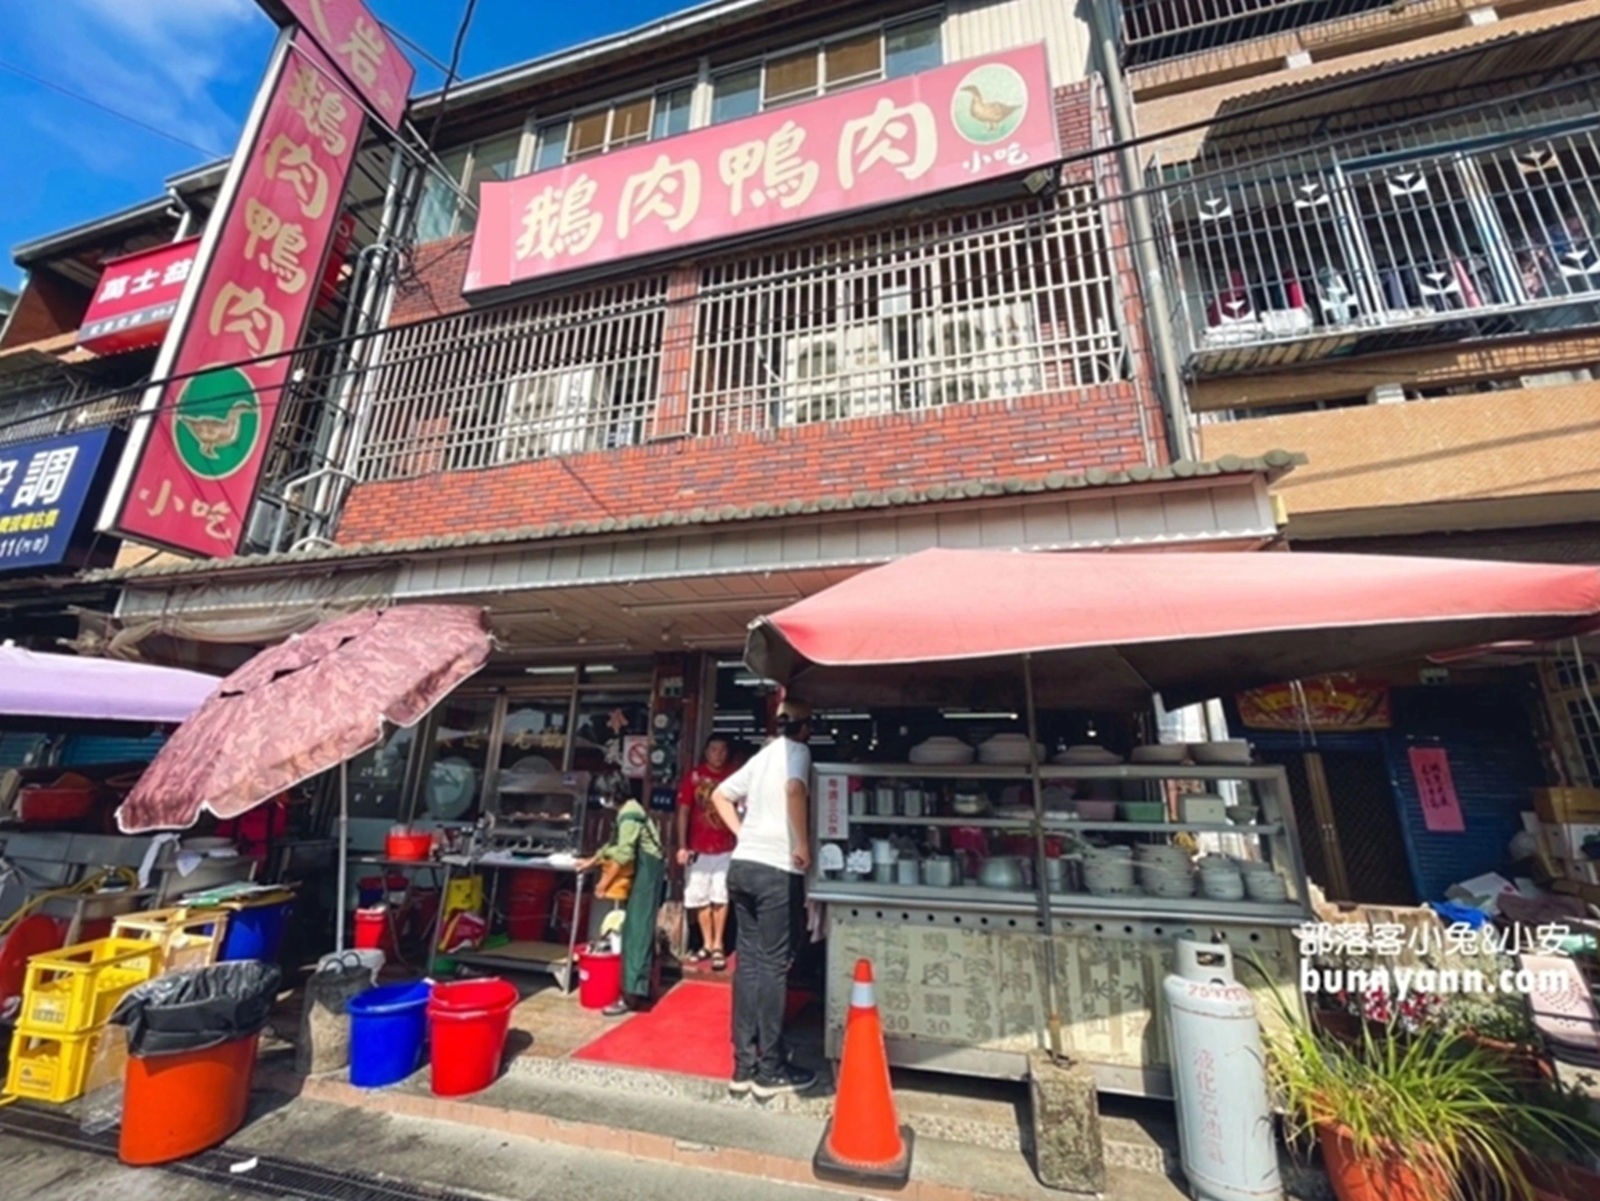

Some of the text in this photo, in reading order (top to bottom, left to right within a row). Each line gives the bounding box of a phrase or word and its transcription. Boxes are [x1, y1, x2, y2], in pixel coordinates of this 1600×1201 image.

[514, 97, 938, 261] 鵝肉鴨肉
[962, 142, 1029, 174] 小吃
[207, 64, 348, 368] 鵝肉鴨肉
[138, 479, 233, 541] 小吃
